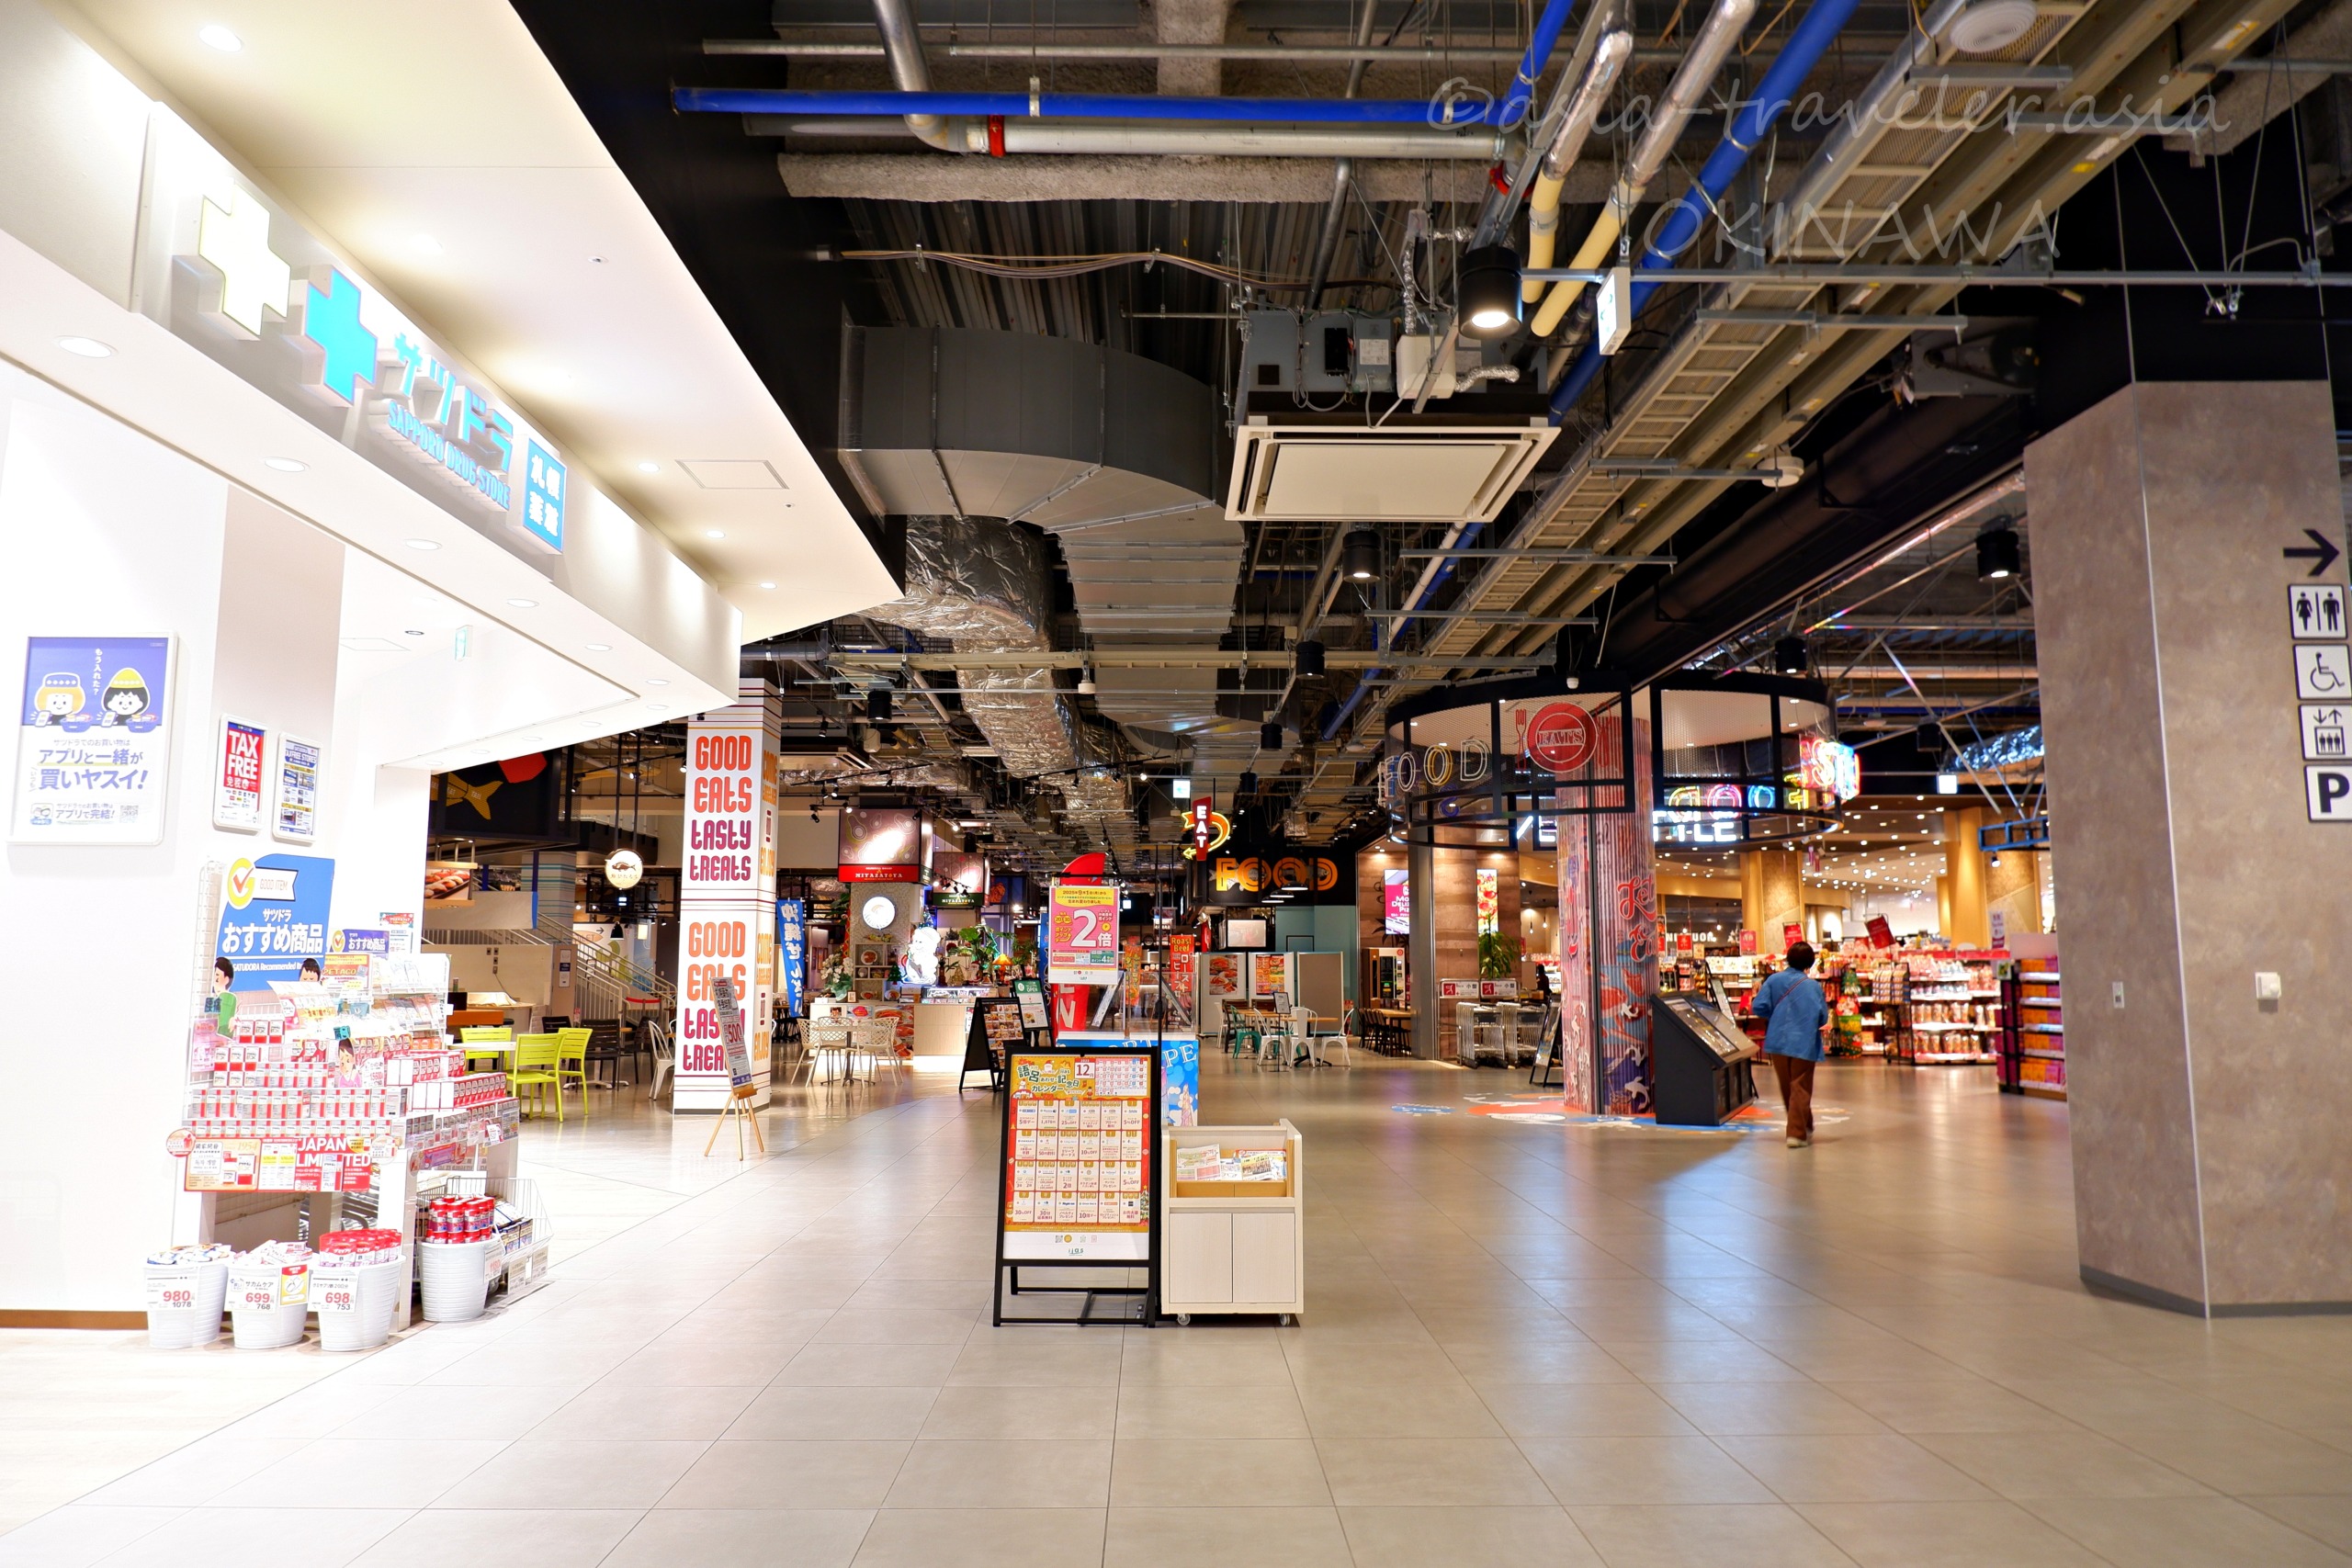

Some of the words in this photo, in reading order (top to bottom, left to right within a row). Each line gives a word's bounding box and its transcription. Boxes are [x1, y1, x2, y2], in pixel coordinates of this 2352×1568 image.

[388, 400, 446, 462] SAPPORO
[446, 441, 476, 486] DRUG
[478, 465, 511, 510] STORE
[229, 730, 259, 759] TAX
[1537, 728, 1584, 746] EATS
[39, 749, 143, 765] アプリと一緒が
[228, 754, 257, 779] FREE
[695, 736, 752, 771] GOOD
[2317, 773, 2350, 814] P
[1196, 805, 1208, 848] EAT
[260, 879, 275, 890] GOOD
[275, 879, 288, 891] ITEM
[1216, 857, 1338, 892] FOOD
[1617, 874, 1657, 922] Let
[262, 908, 292, 922] サツドラ
[1070, 909, 1097, 947] 2
[222, 922, 324, 954] おすすめ商品
[688, 921, 746, 958] GOOD
[1098, 933, 1112, 947] 倍
[233, 962, 260, 971] SATUDORA
[684, 1008, 746, 1040] TAS
[298, 1138, 346, 1151] JAPAN
[163, 1290, 191, 1302] 980
[246, 1293, 270, 1303] 699
[325, 1292, 350, 1303] 698
